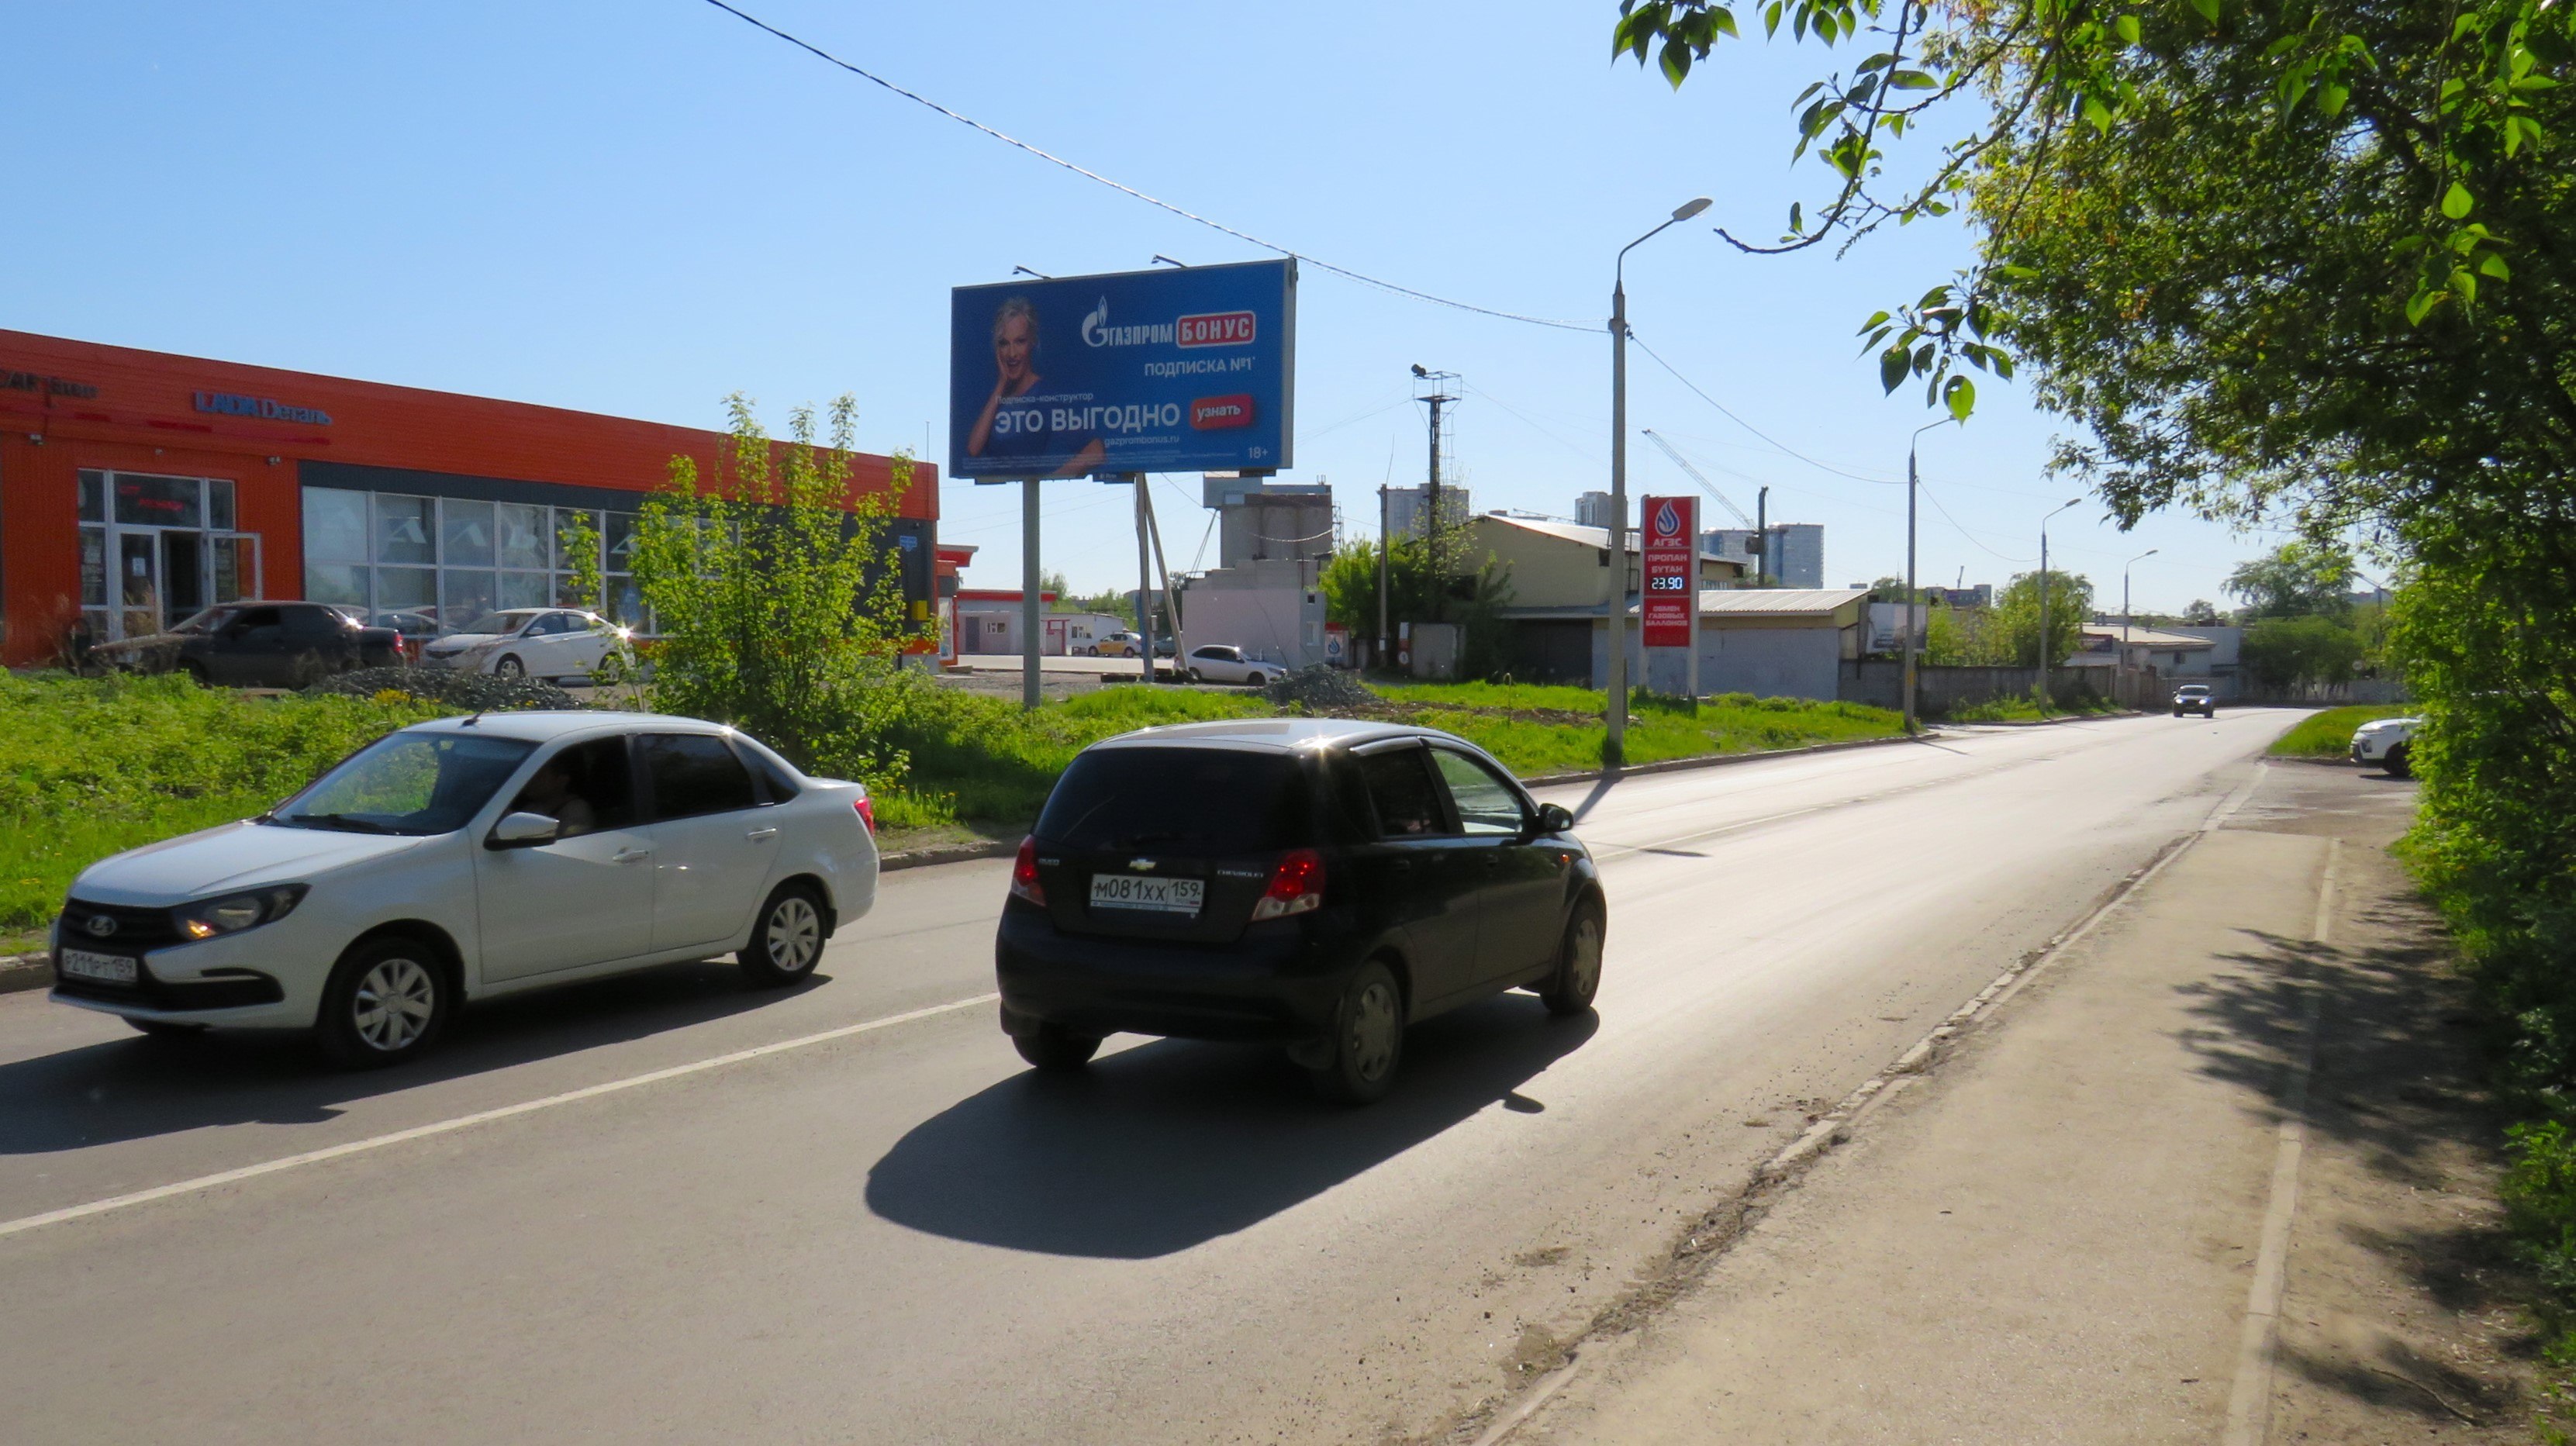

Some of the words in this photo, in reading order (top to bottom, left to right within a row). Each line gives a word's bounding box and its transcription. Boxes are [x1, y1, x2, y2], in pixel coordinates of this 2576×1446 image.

[1182, 317, 1250, 341] БОНУС
[1144, 358, 1227, 378] ПОДПИСКА
[996, 392, 1094, 405] Подписка-конструктор
[995, 409, 1044, 433] ЭТО
[1051, 402, 1181, 433] ВЫГОДНО
[1196, 404, 1241, 423] узнать
[1104, 436, 1180, 448] gazprombonus.ru
[1248, 447, 1269, 459] 18+
[1652, 538, 1683, 547] АГЗС
[1648, 554, 1687, 563] ПРОПАН
[1651, 577, 1683, 590] 23.90
